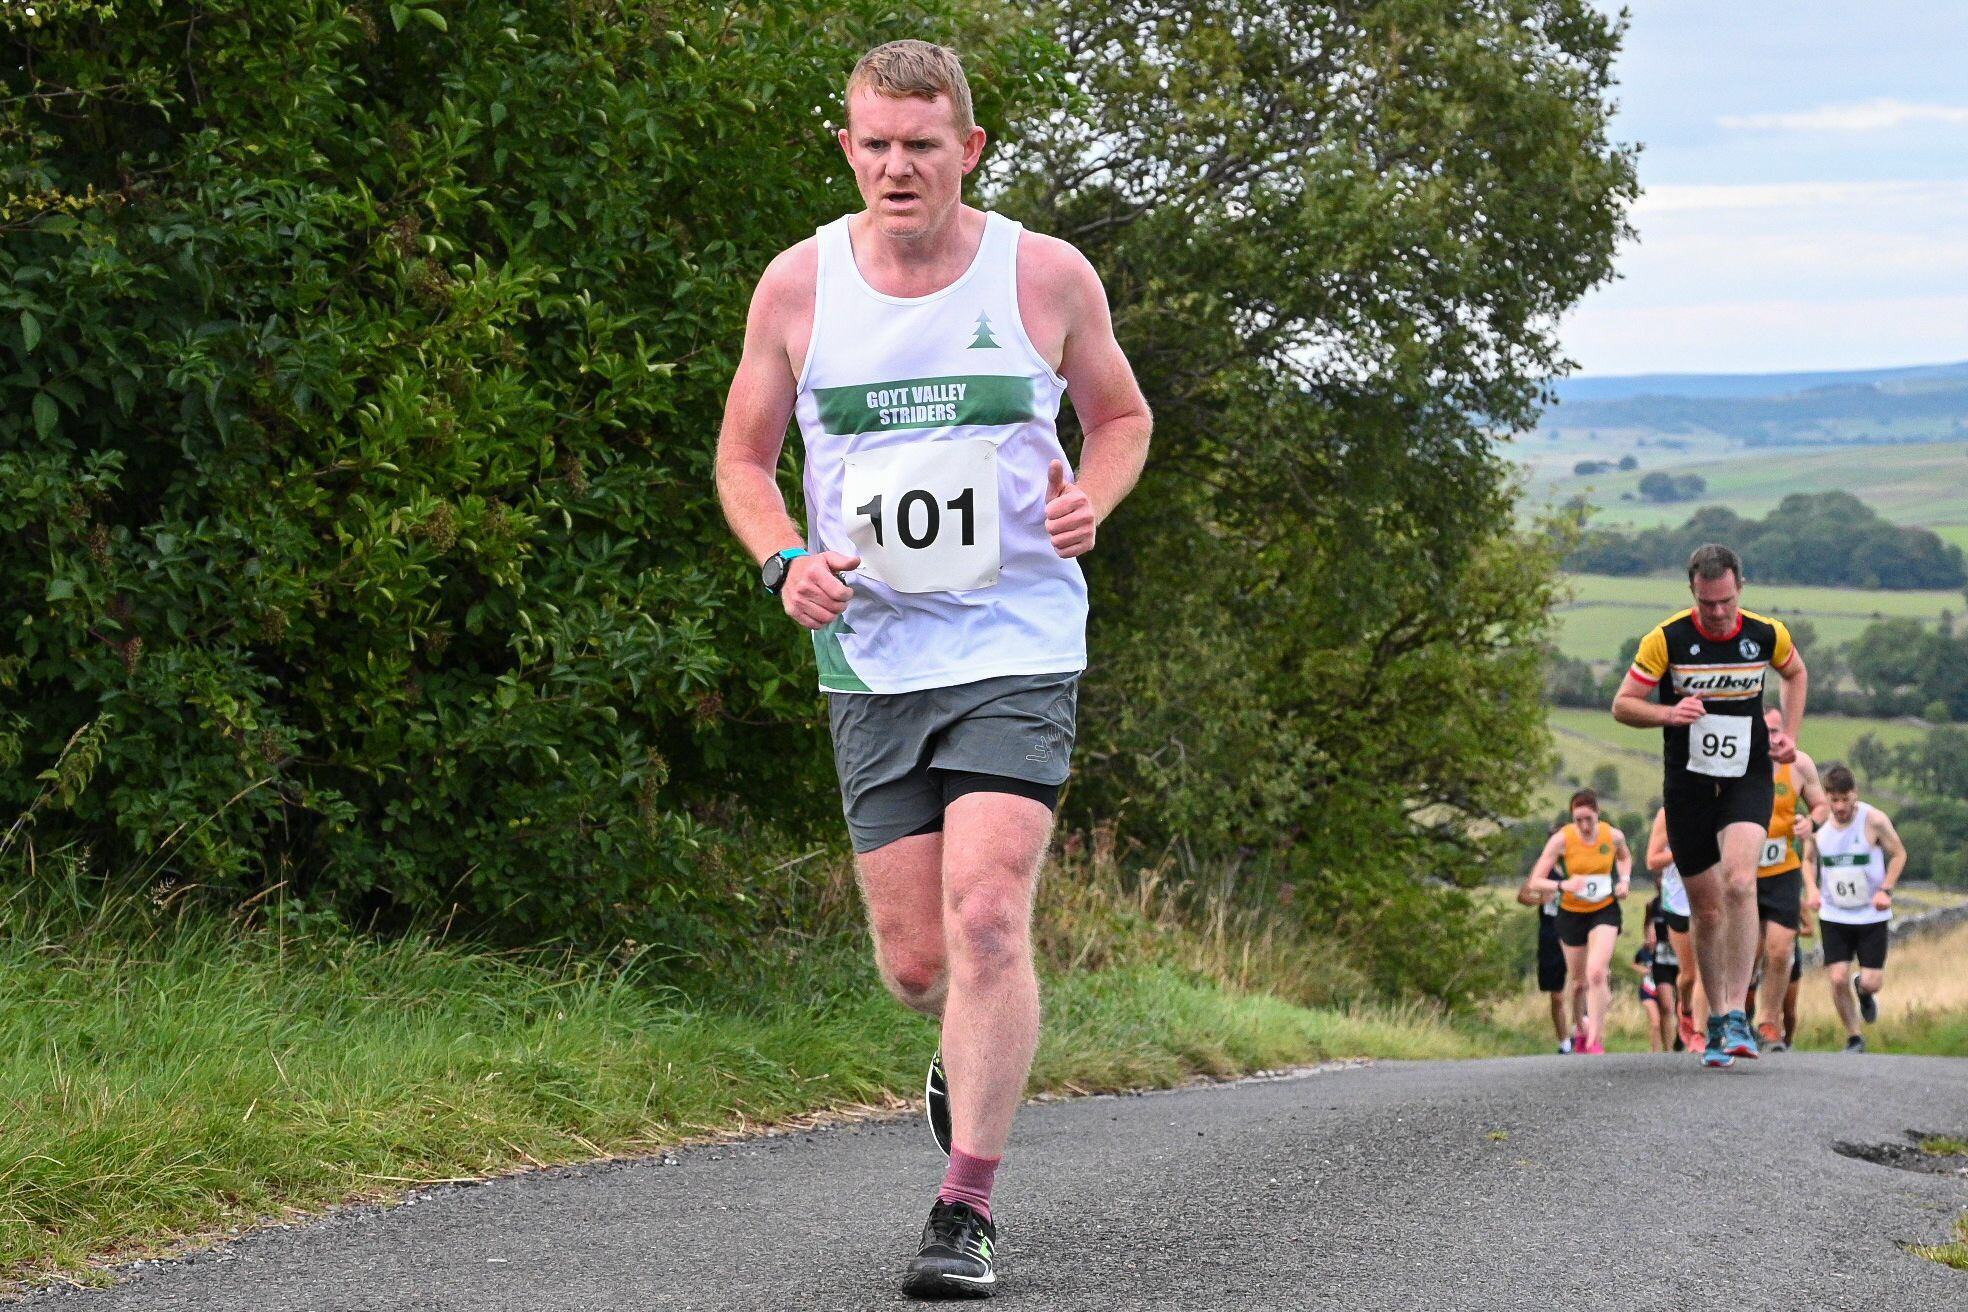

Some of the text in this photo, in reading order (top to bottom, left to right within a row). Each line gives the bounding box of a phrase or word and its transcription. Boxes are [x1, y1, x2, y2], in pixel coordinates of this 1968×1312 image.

[866, 383, 967, 408] GOYT VALLEY
[880, 403, 957, 425] STRIDERS
[856, 488, 975, 550] 101
[1702, 733, 1738, 759] 95
[1836, 880, 1856, 897] 61
